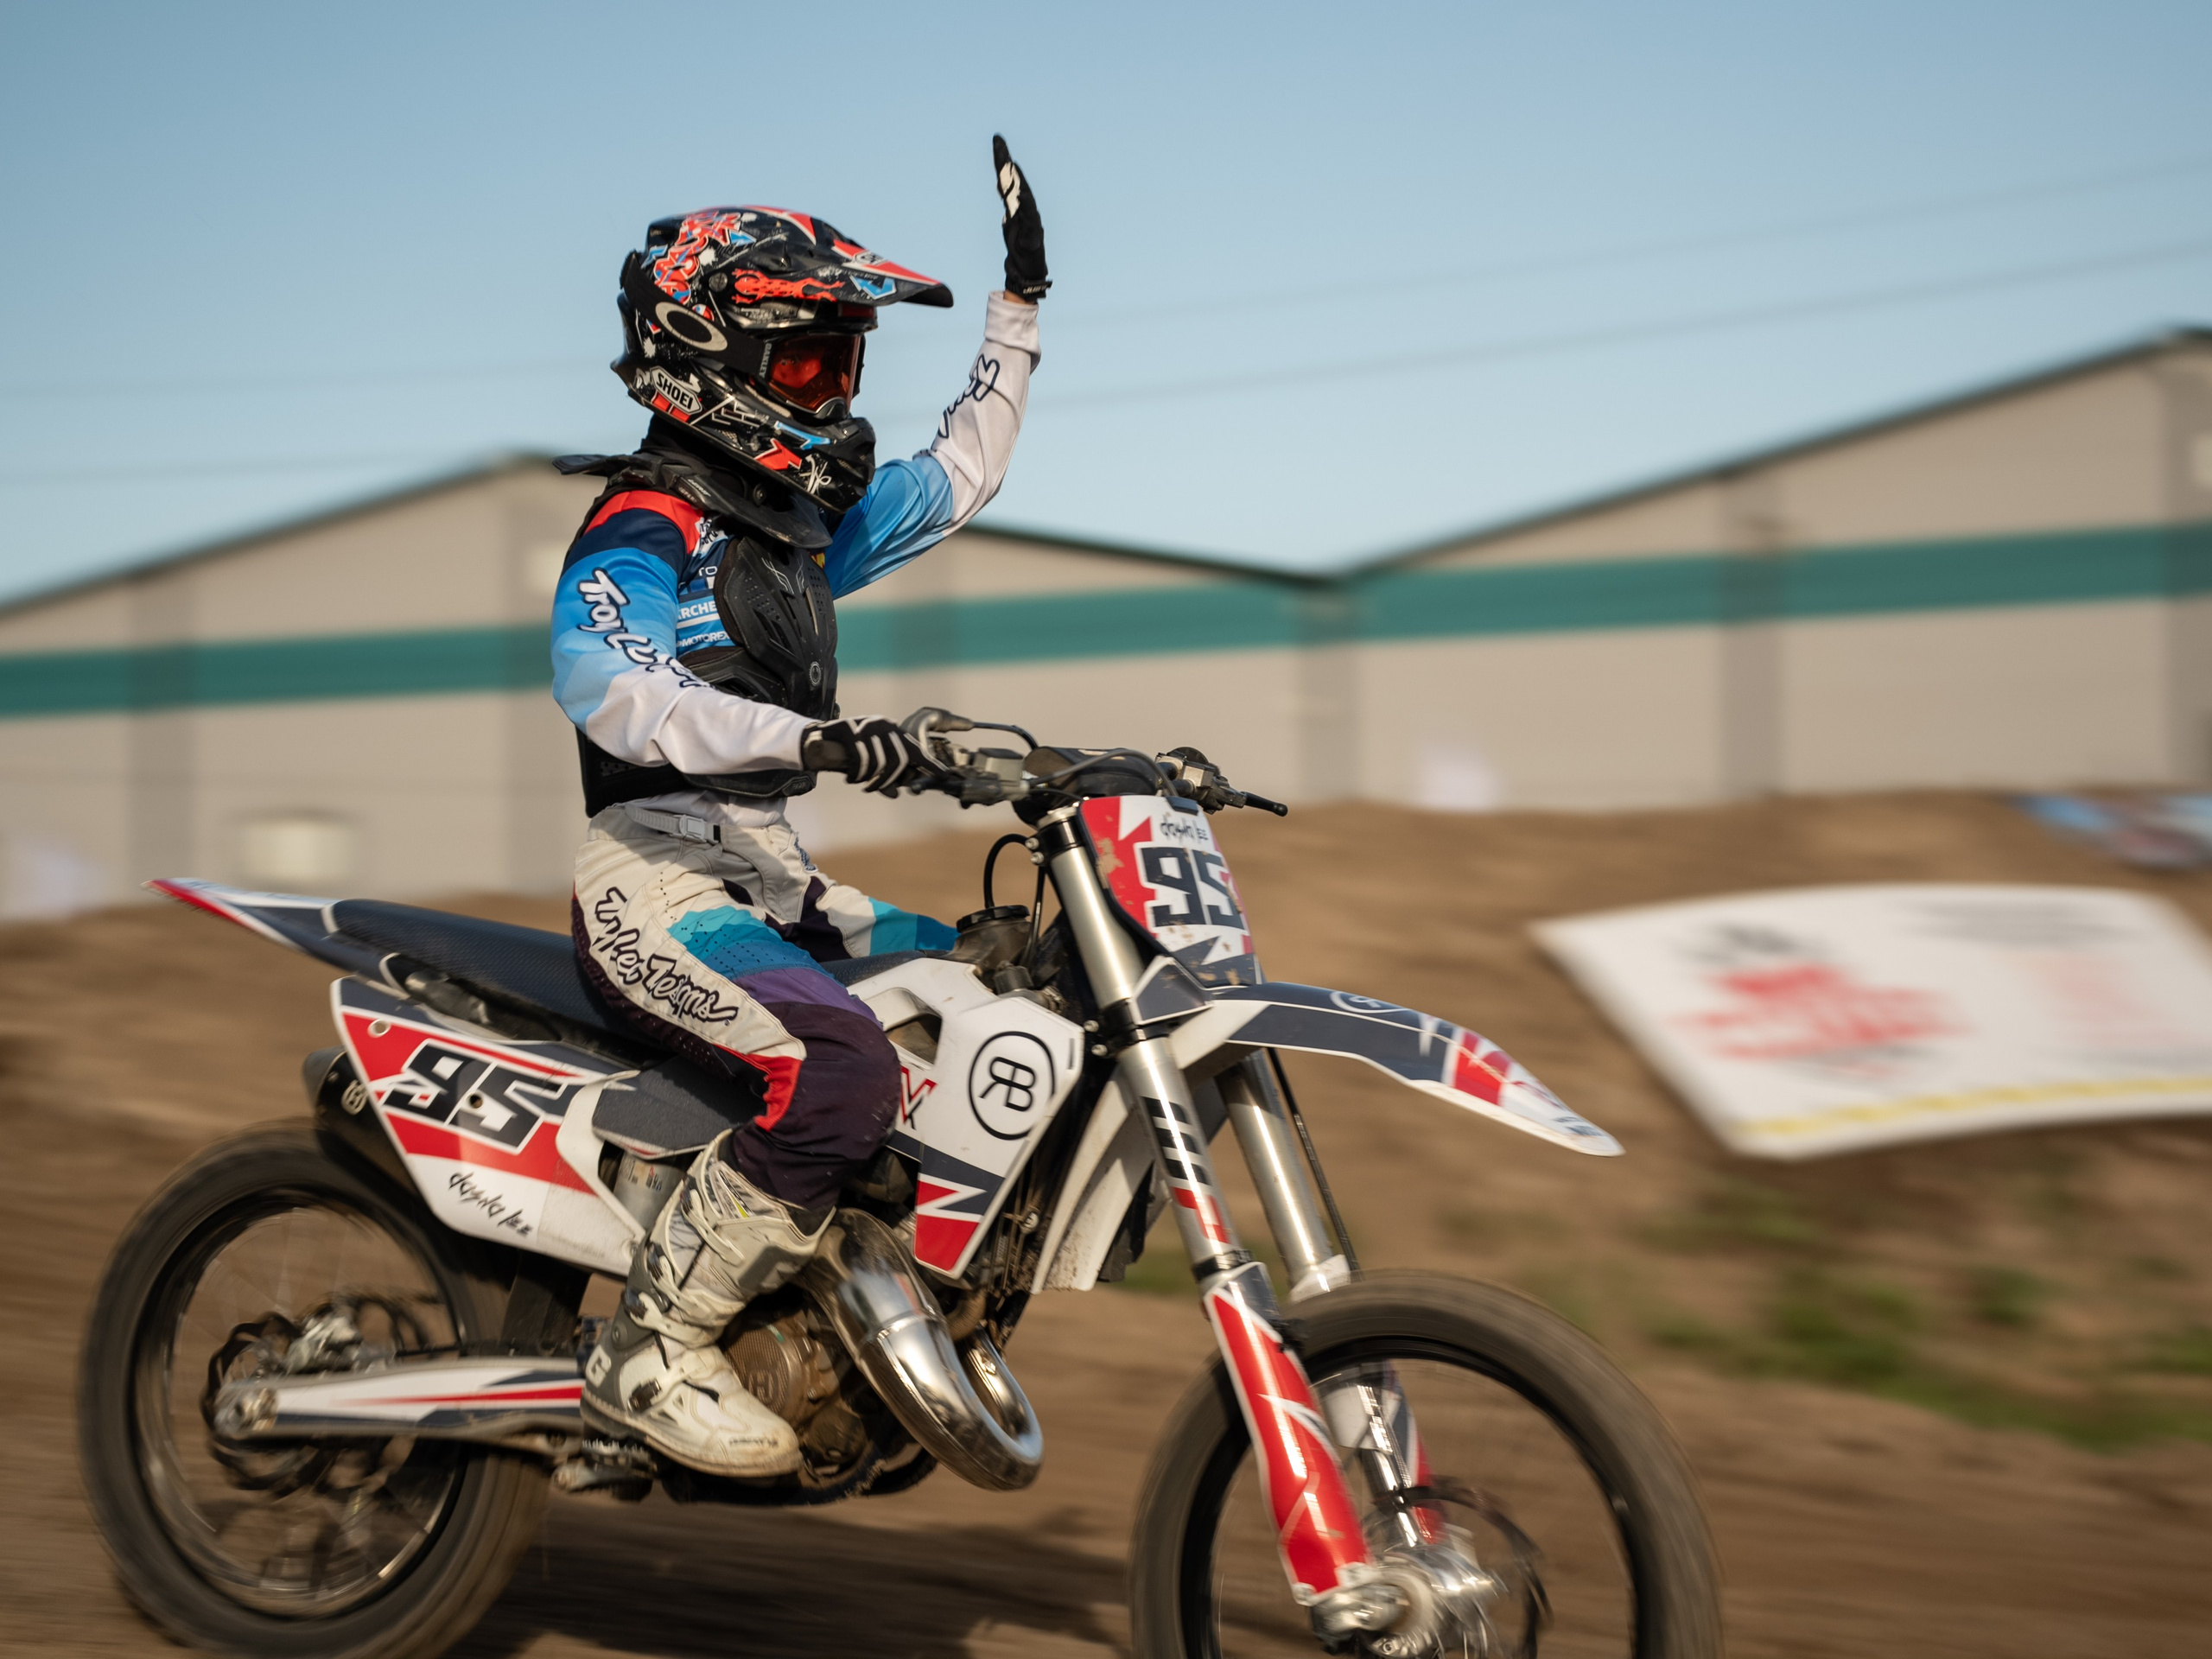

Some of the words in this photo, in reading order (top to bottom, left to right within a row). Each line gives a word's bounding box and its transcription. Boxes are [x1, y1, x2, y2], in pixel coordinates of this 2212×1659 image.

[656, 372, 694, 410] SHOEI
[758, 343, 772, 378] OAKLEY
[576, 566, 631, 635] Troy
[1141, 847, 1245, 930] 95
[383, 1042, 566, 1149] 95
